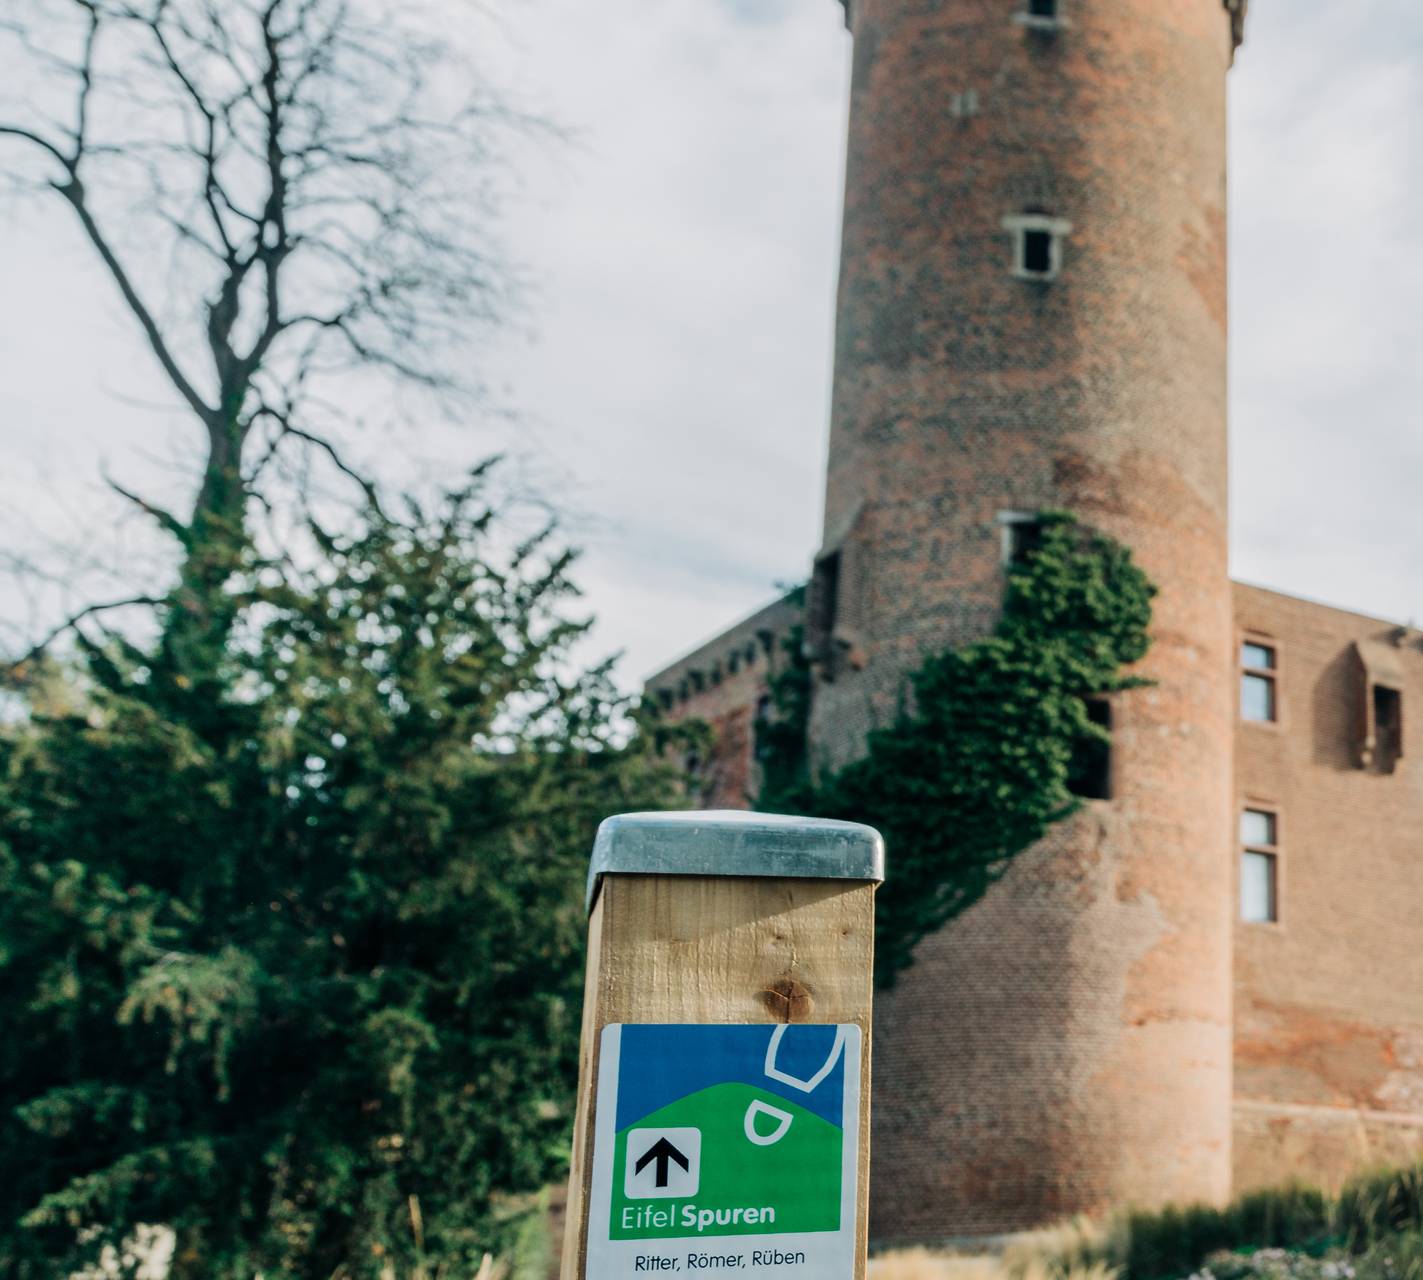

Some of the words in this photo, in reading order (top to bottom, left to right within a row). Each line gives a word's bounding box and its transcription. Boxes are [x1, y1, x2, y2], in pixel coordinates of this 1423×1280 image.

[621, 1204, 675, 1229] Eifel
[681, 1204, 775, 1232] Spuren
[635, 1255, 681, 1272] Ritter,
[687, 1252, 746, 1270] Römer,
[752, 1250, 805, 1267] Rüben
